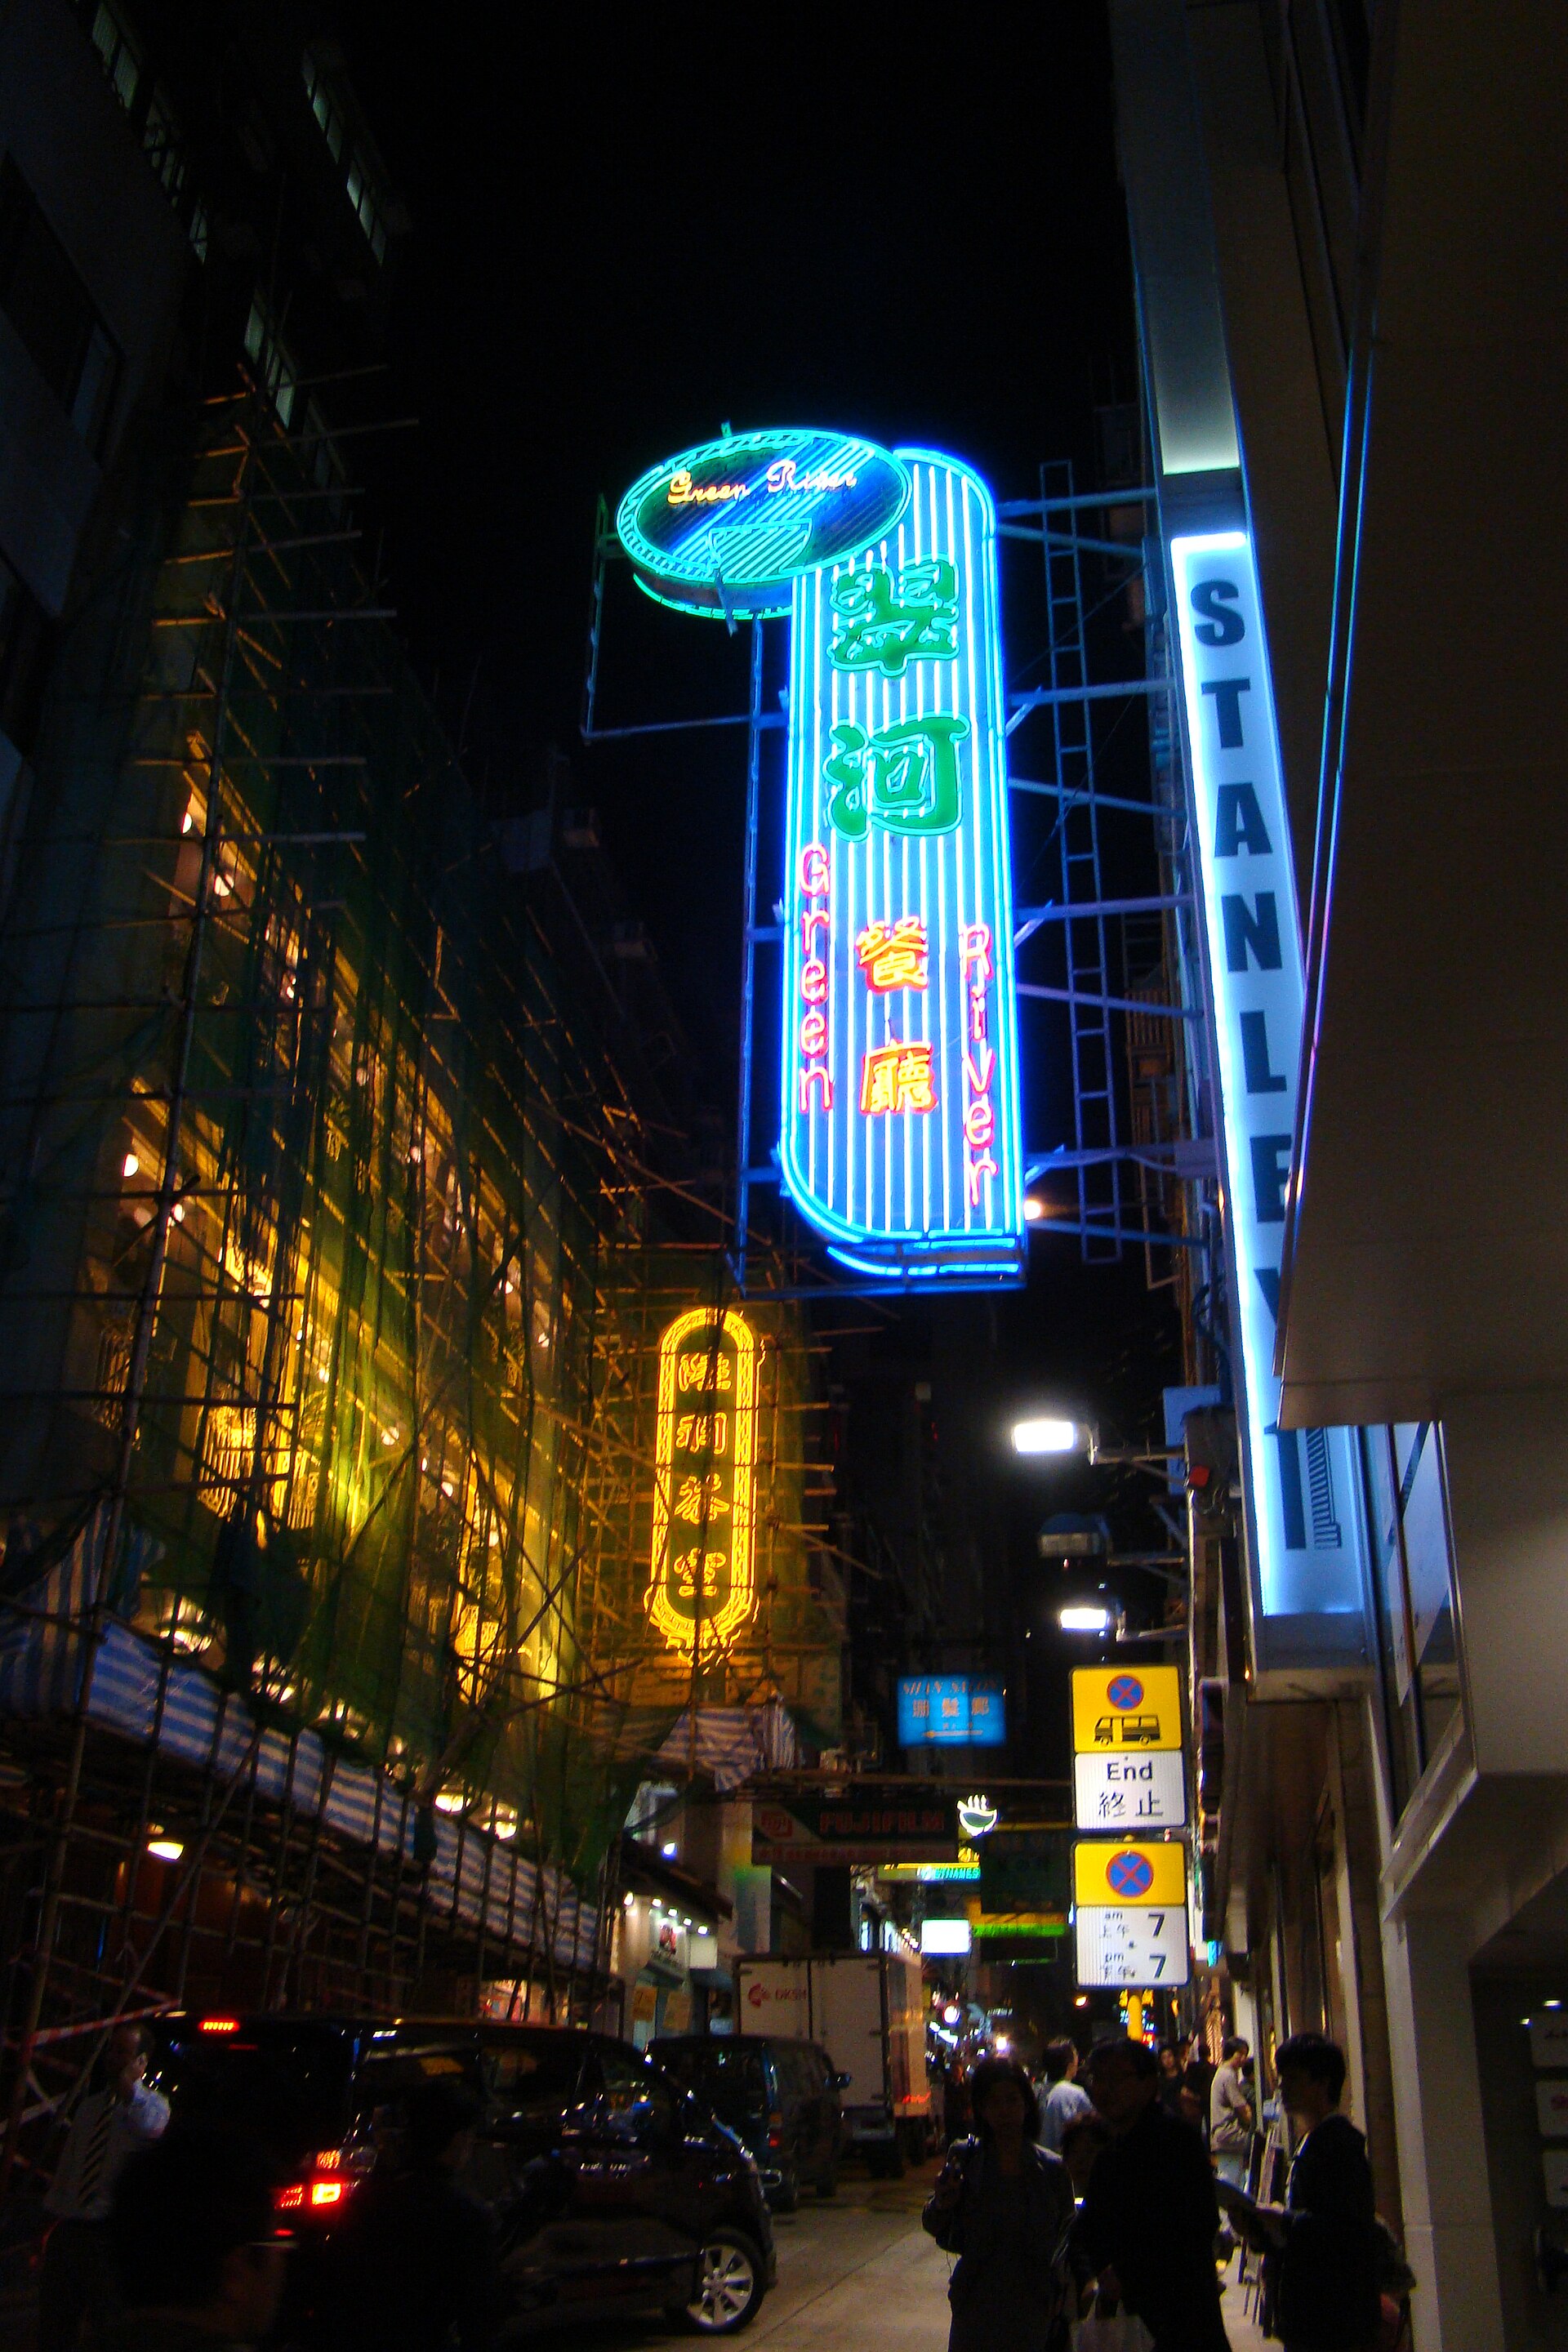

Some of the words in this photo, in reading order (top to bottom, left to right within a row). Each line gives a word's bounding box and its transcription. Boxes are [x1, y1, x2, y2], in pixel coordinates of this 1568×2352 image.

[667, 470, 751, 505] Green
[767, 458, 858, 493] River
[799, 843, 835, 1111] Green
[1107, 1759, 1153, 1781] End
[1098, 1788, 1164, 1817] 終止
[818, 1809, 947, 1833] FUJIFILM
[1147, 1913, 1165, 1938] 7
[1148, 1953, 1166, 1979] 7
